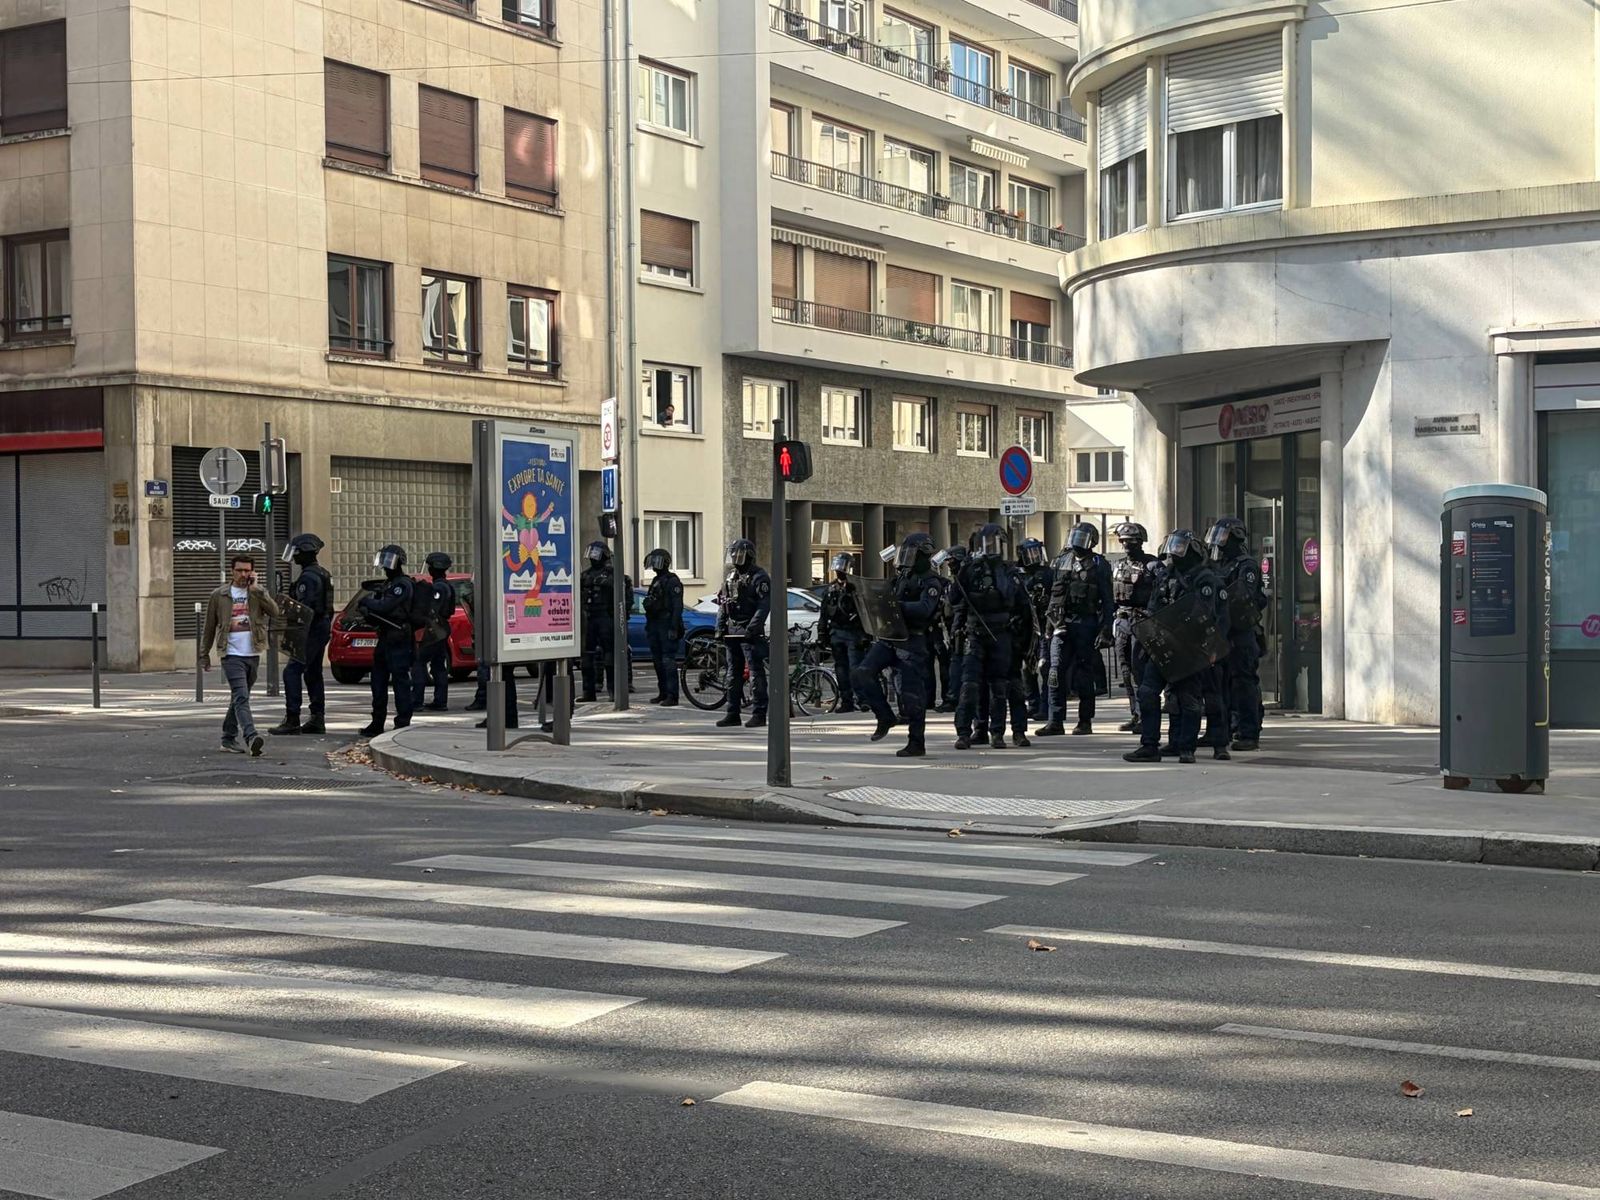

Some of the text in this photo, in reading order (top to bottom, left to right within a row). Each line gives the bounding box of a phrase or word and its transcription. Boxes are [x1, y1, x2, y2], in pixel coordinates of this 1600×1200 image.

[508, 468, 566, 497] EXPLORE TA SANTÉ
[213, 496, 230, 505] SAUF
[548, 607, 570, 615] octobre
